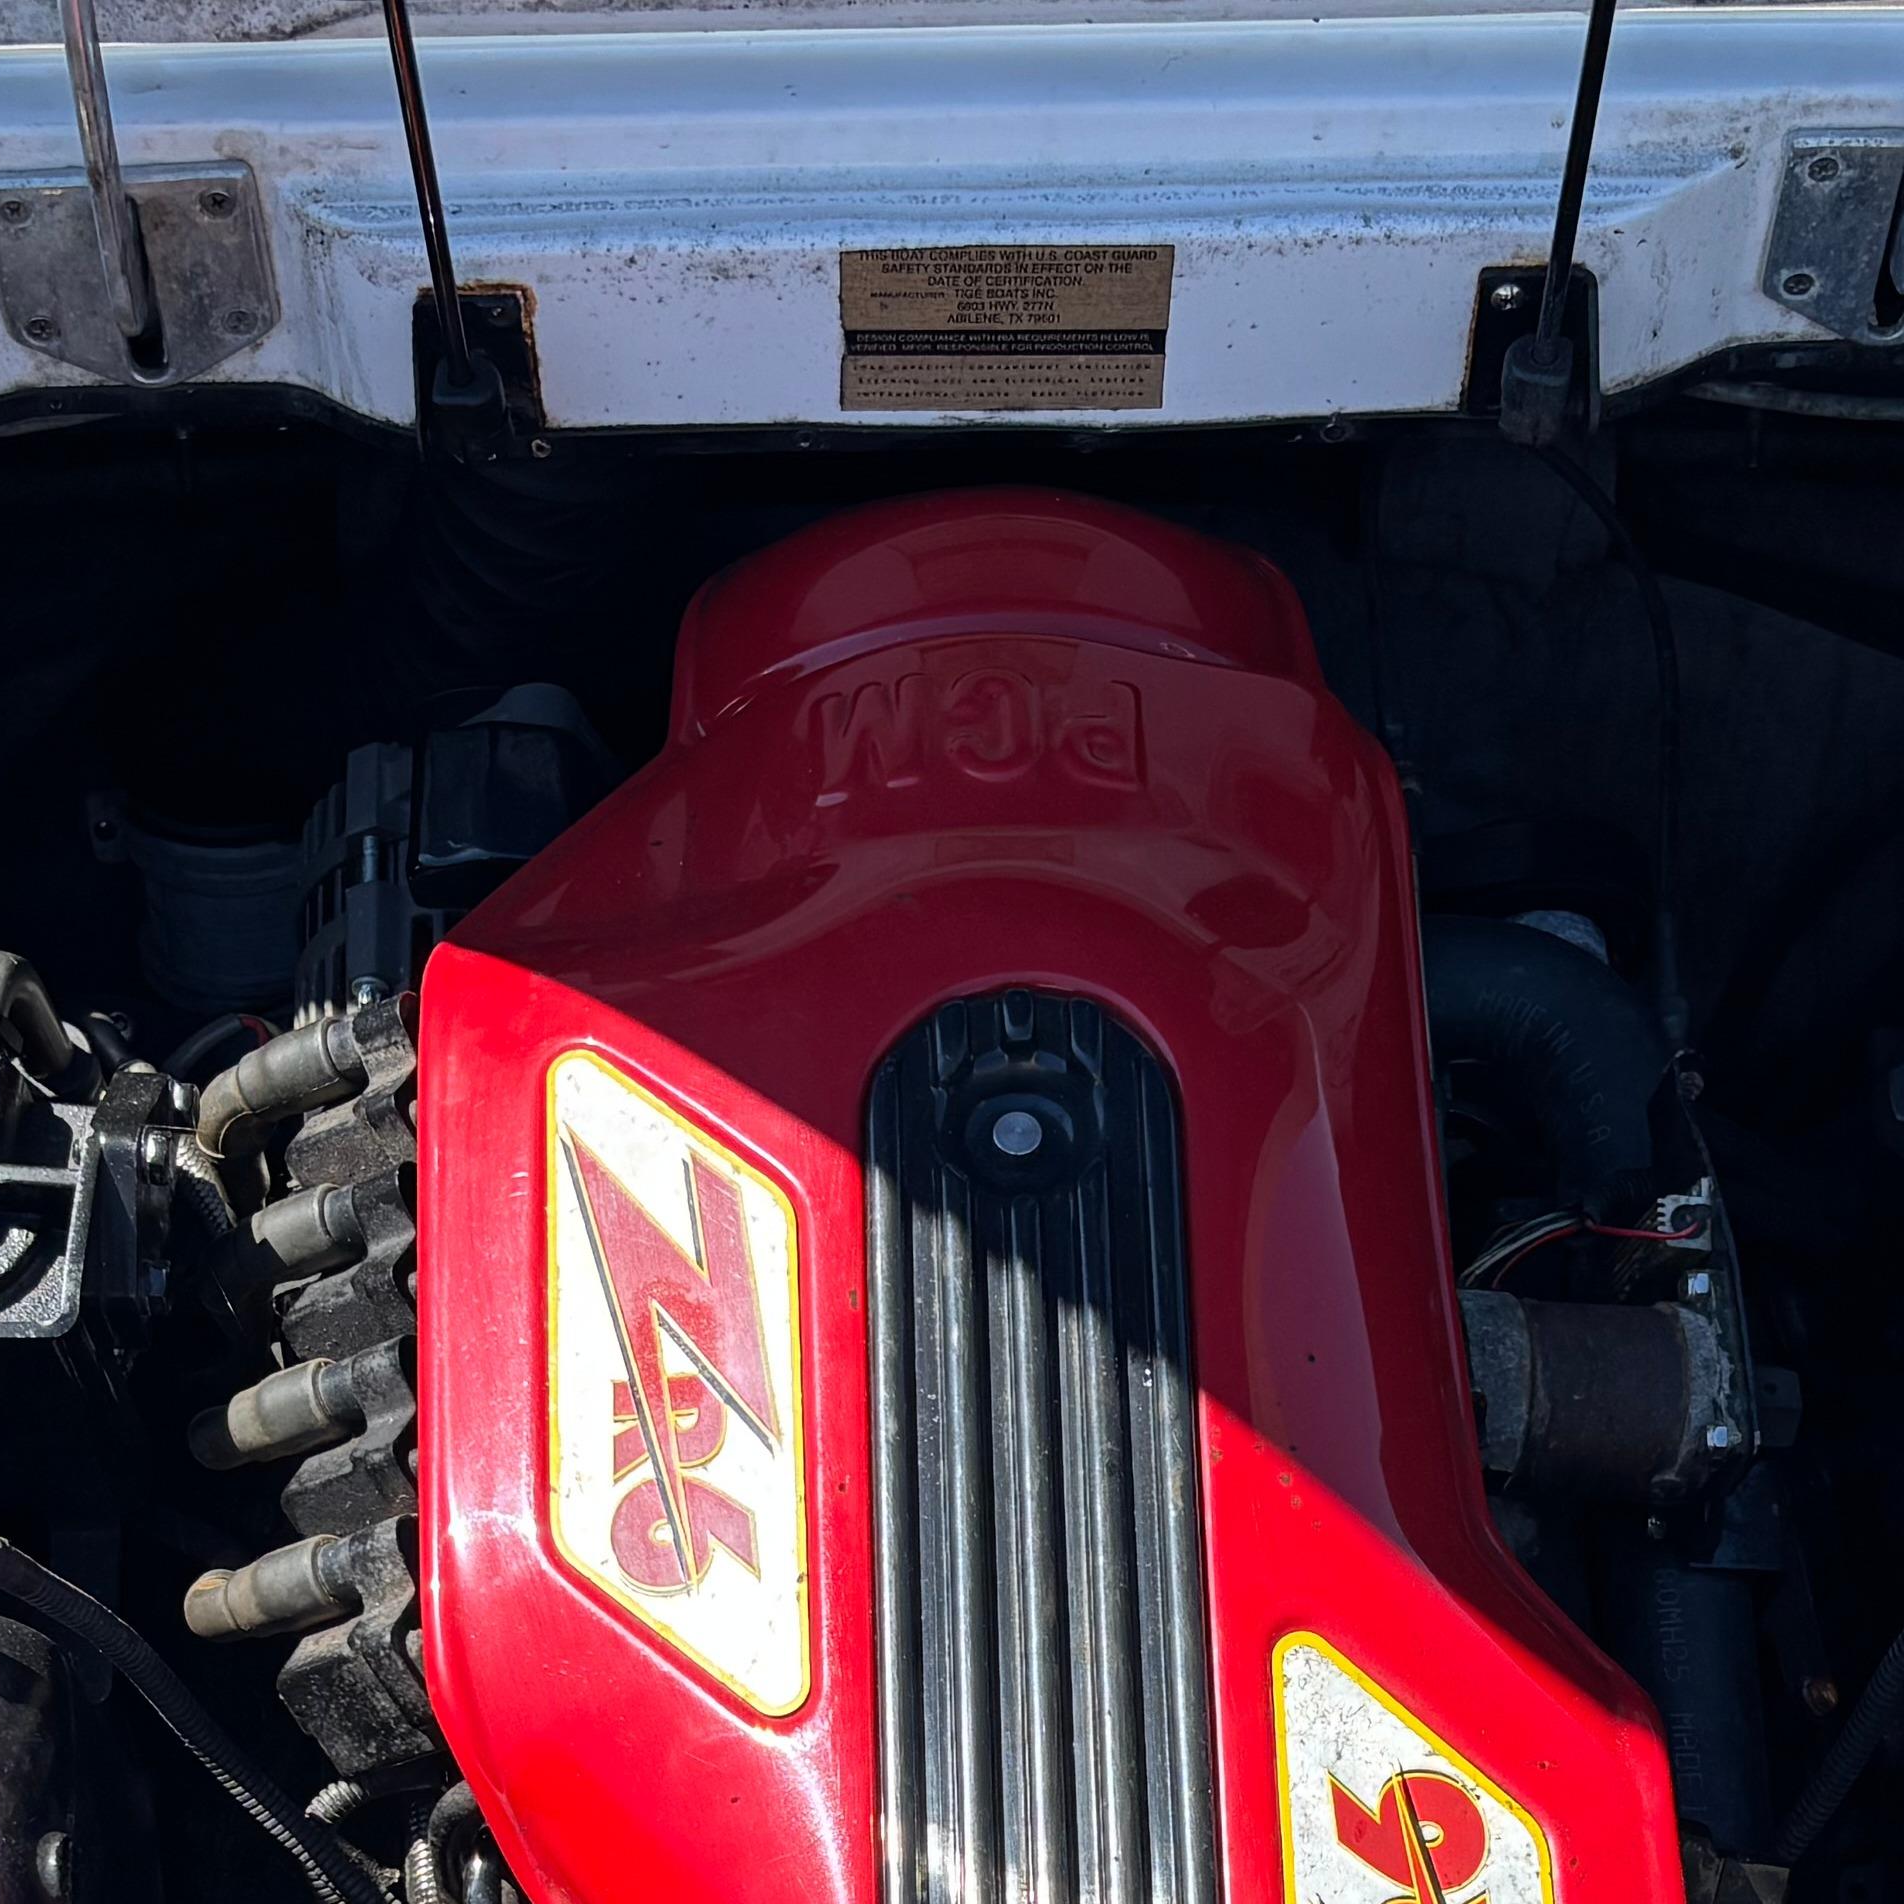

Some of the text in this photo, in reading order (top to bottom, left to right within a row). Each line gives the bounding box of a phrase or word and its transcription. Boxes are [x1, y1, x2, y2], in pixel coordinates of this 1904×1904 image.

[929, 250, 996, 261] COMPLIES
[1000, 250, 1032, 261] WITH
[1064, 250, 1108, 260] COAST
[1112, 250, 1157, 260] GUARD
[881, 263, 1133, 274] SAFETY STANDARDS IN EFFECT ON THE
[927, 276, 960, 287] DATE
[964, 276, 981, 287] OF
[986, 288, 1030, 299] BOATS
[1009, 313, 1023, 324] TX
